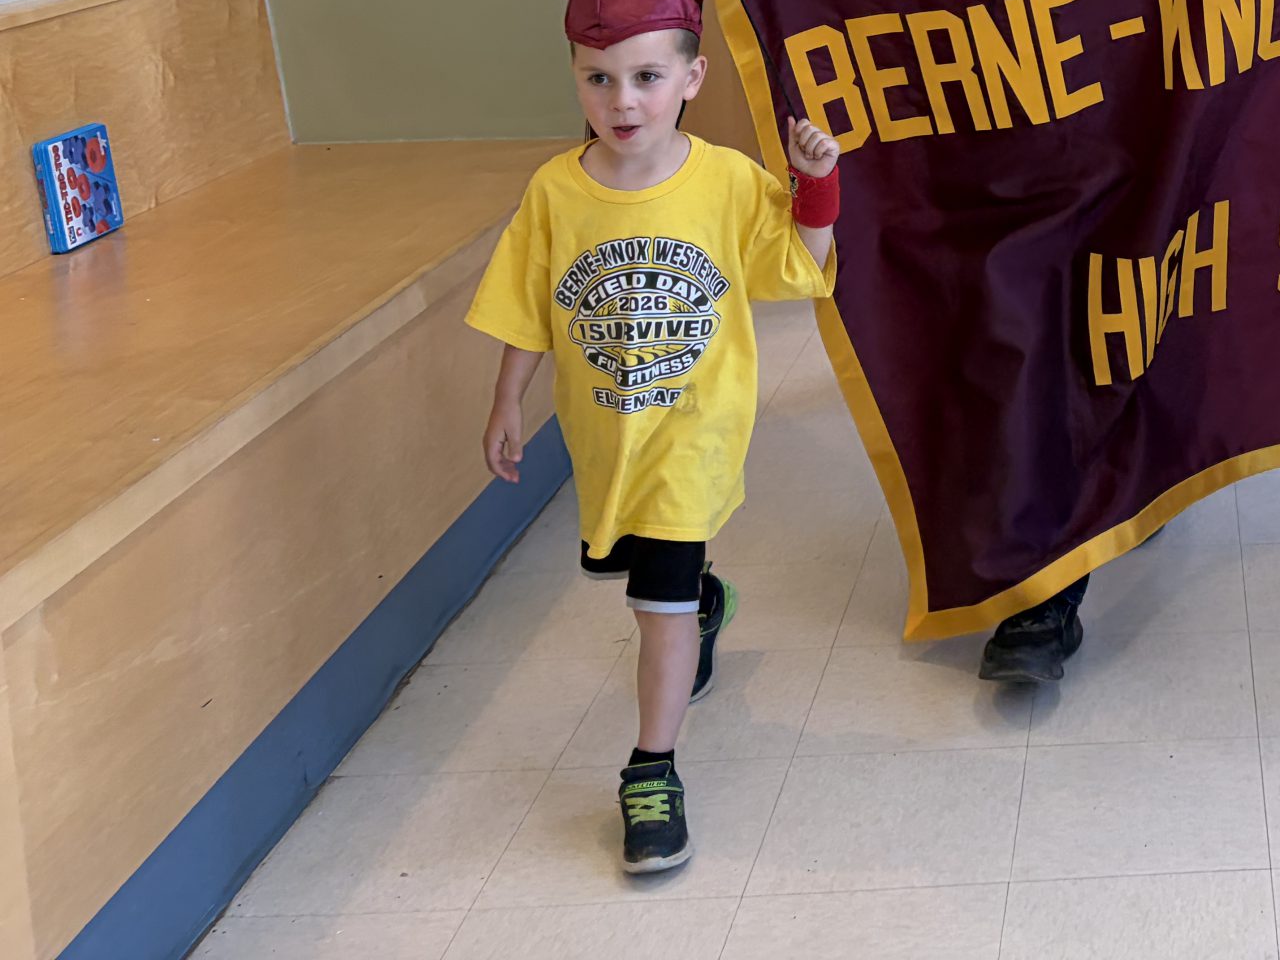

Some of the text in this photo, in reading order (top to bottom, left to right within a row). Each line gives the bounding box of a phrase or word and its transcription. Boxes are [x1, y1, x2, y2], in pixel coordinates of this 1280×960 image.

[554, 238, 729, 309] BERNE-KNOX WESTERLO
[588, 273, 701, 308] FIELD DAY
[618, 295, 668, 311] 2026
[1088, 200, 1230, 386] HIGH
[590, 319, 713, 341] SURVIVED
[597, 355, 616, 372] FU
[628, 353, 694, 385] FITNESS
